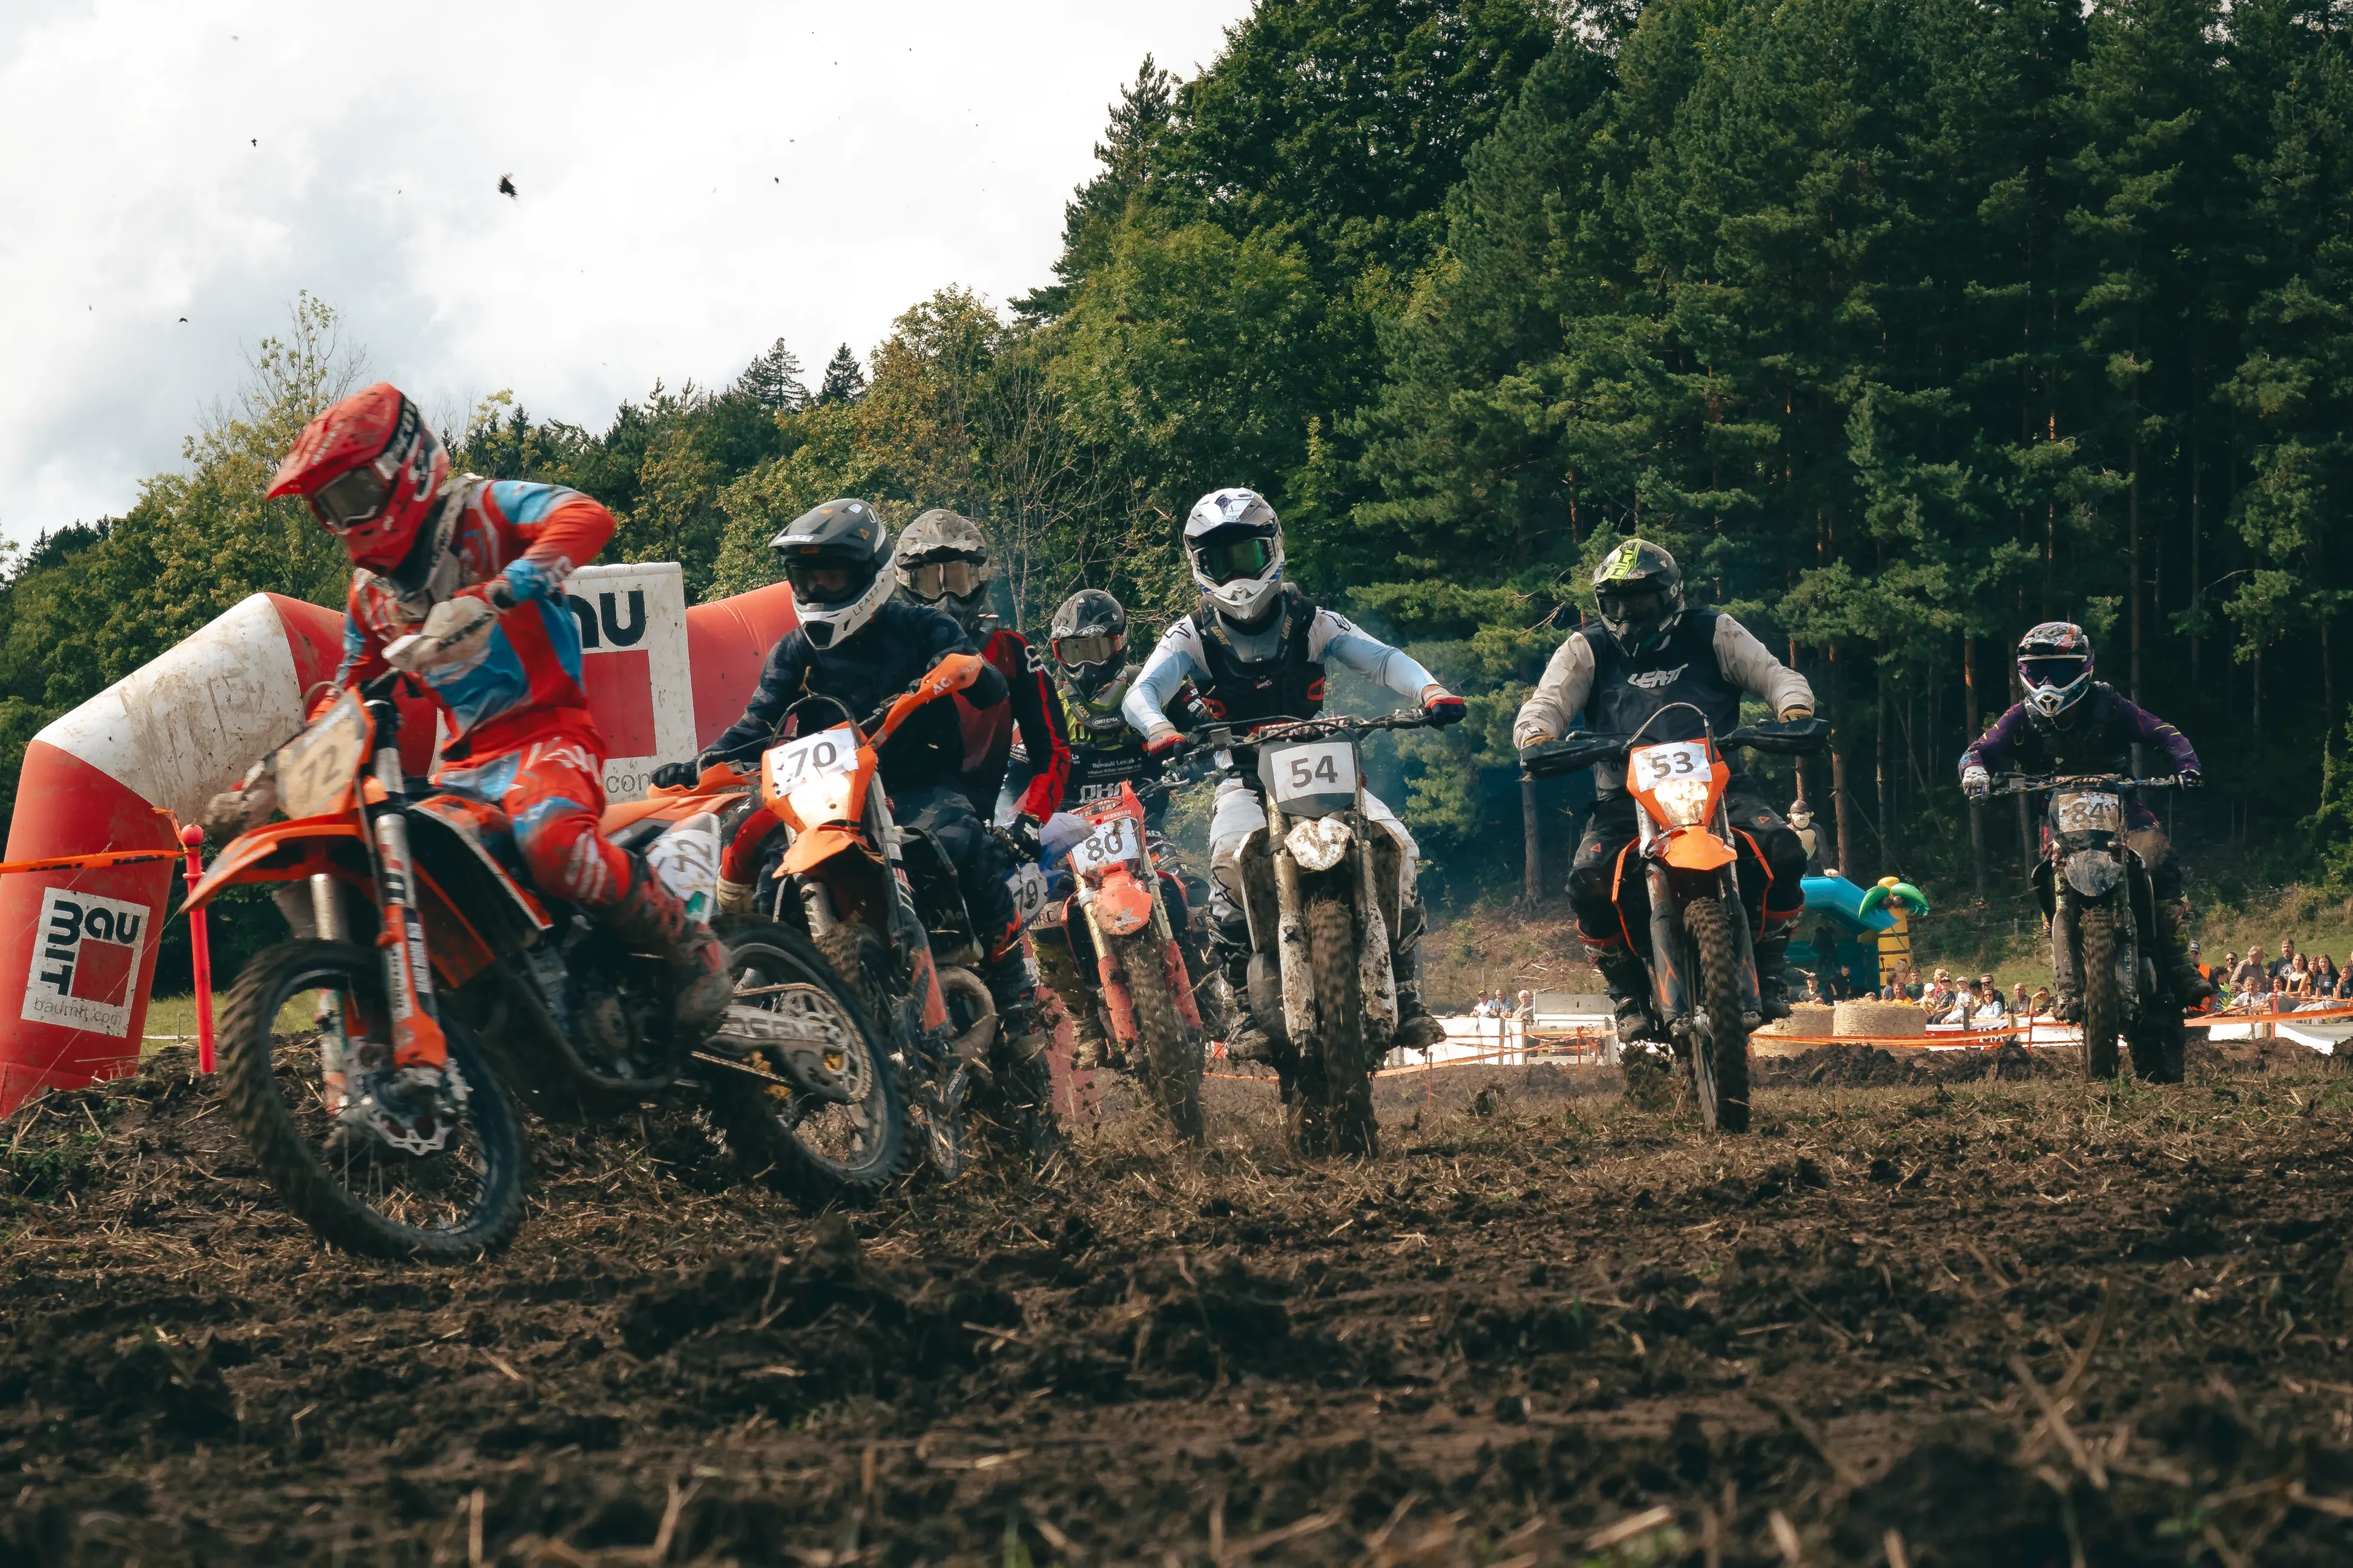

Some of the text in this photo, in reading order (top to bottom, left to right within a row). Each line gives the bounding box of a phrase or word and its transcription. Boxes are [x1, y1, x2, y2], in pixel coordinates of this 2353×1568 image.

[852, 585, 879, 617] LEATT
[568, 590, 647, 647] au
[1211, 626, 1231, 646] LEATT
[1627, 663, 1689, 688] LEATT
[1094, 717, 1119, 725] ORTEMA
[788, 742, 837, 778] 70
[1291, 755, 1338, 788] 54
[1652, 752, 1694, 779] 53
[2072, 802, 2107, 824] 84
[1085, 832, 1123, 861] 80
[1013, 879, 1038, 915] 79
[34, 997, 122, 1026] baumit.com
